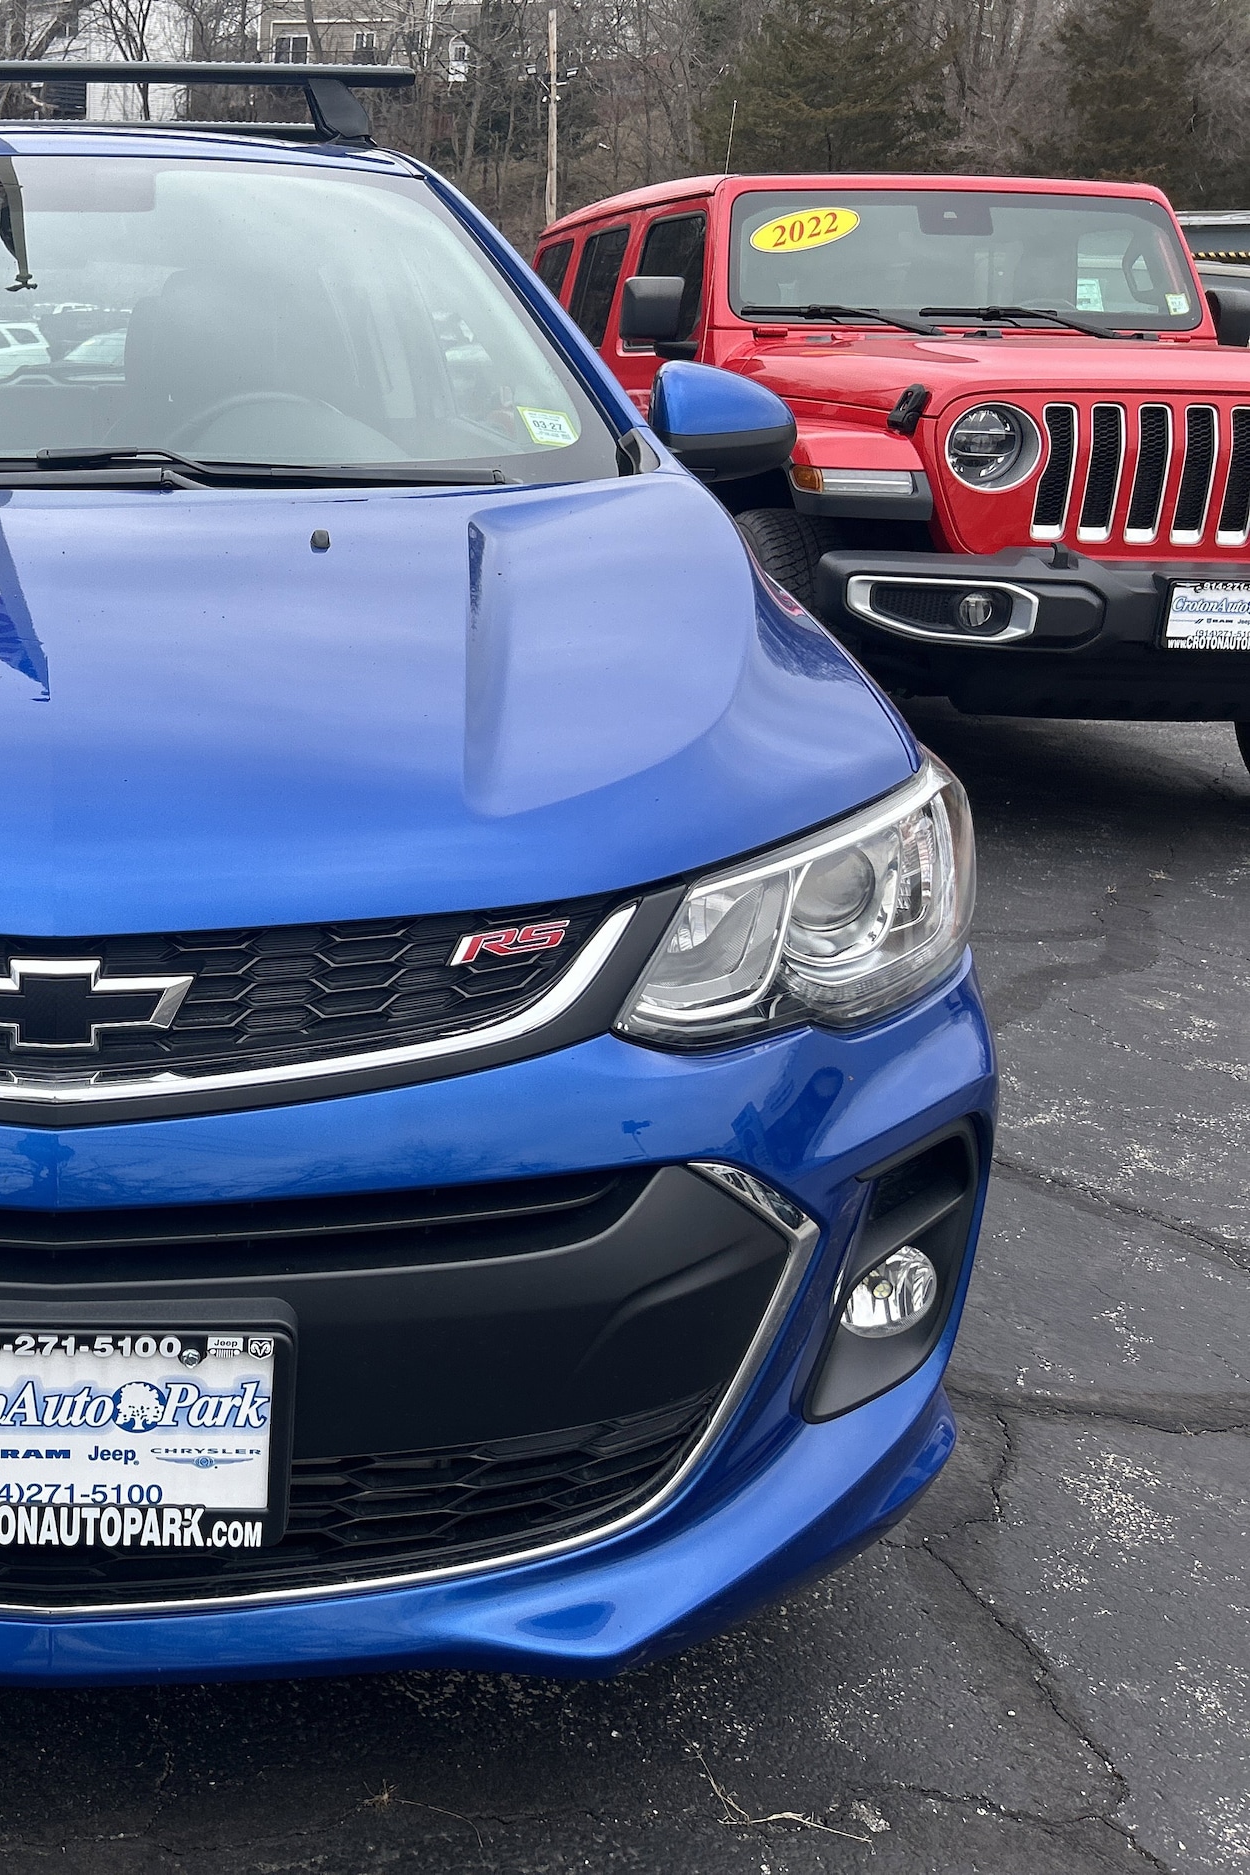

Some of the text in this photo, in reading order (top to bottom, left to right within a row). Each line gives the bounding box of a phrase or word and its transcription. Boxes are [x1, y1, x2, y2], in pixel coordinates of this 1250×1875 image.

[772, 212, 839, 248] 2022
[450, 919, 570, 966] RS
[214, 1339, 238, 1347] Jeep
[156, 1381, 269, 1427] Park
[0, 1449, 71, 1459] RAM
[88, 1446, 136, 1465] Jeep
[150, 1447, 262, 1455] CHRYSLER
